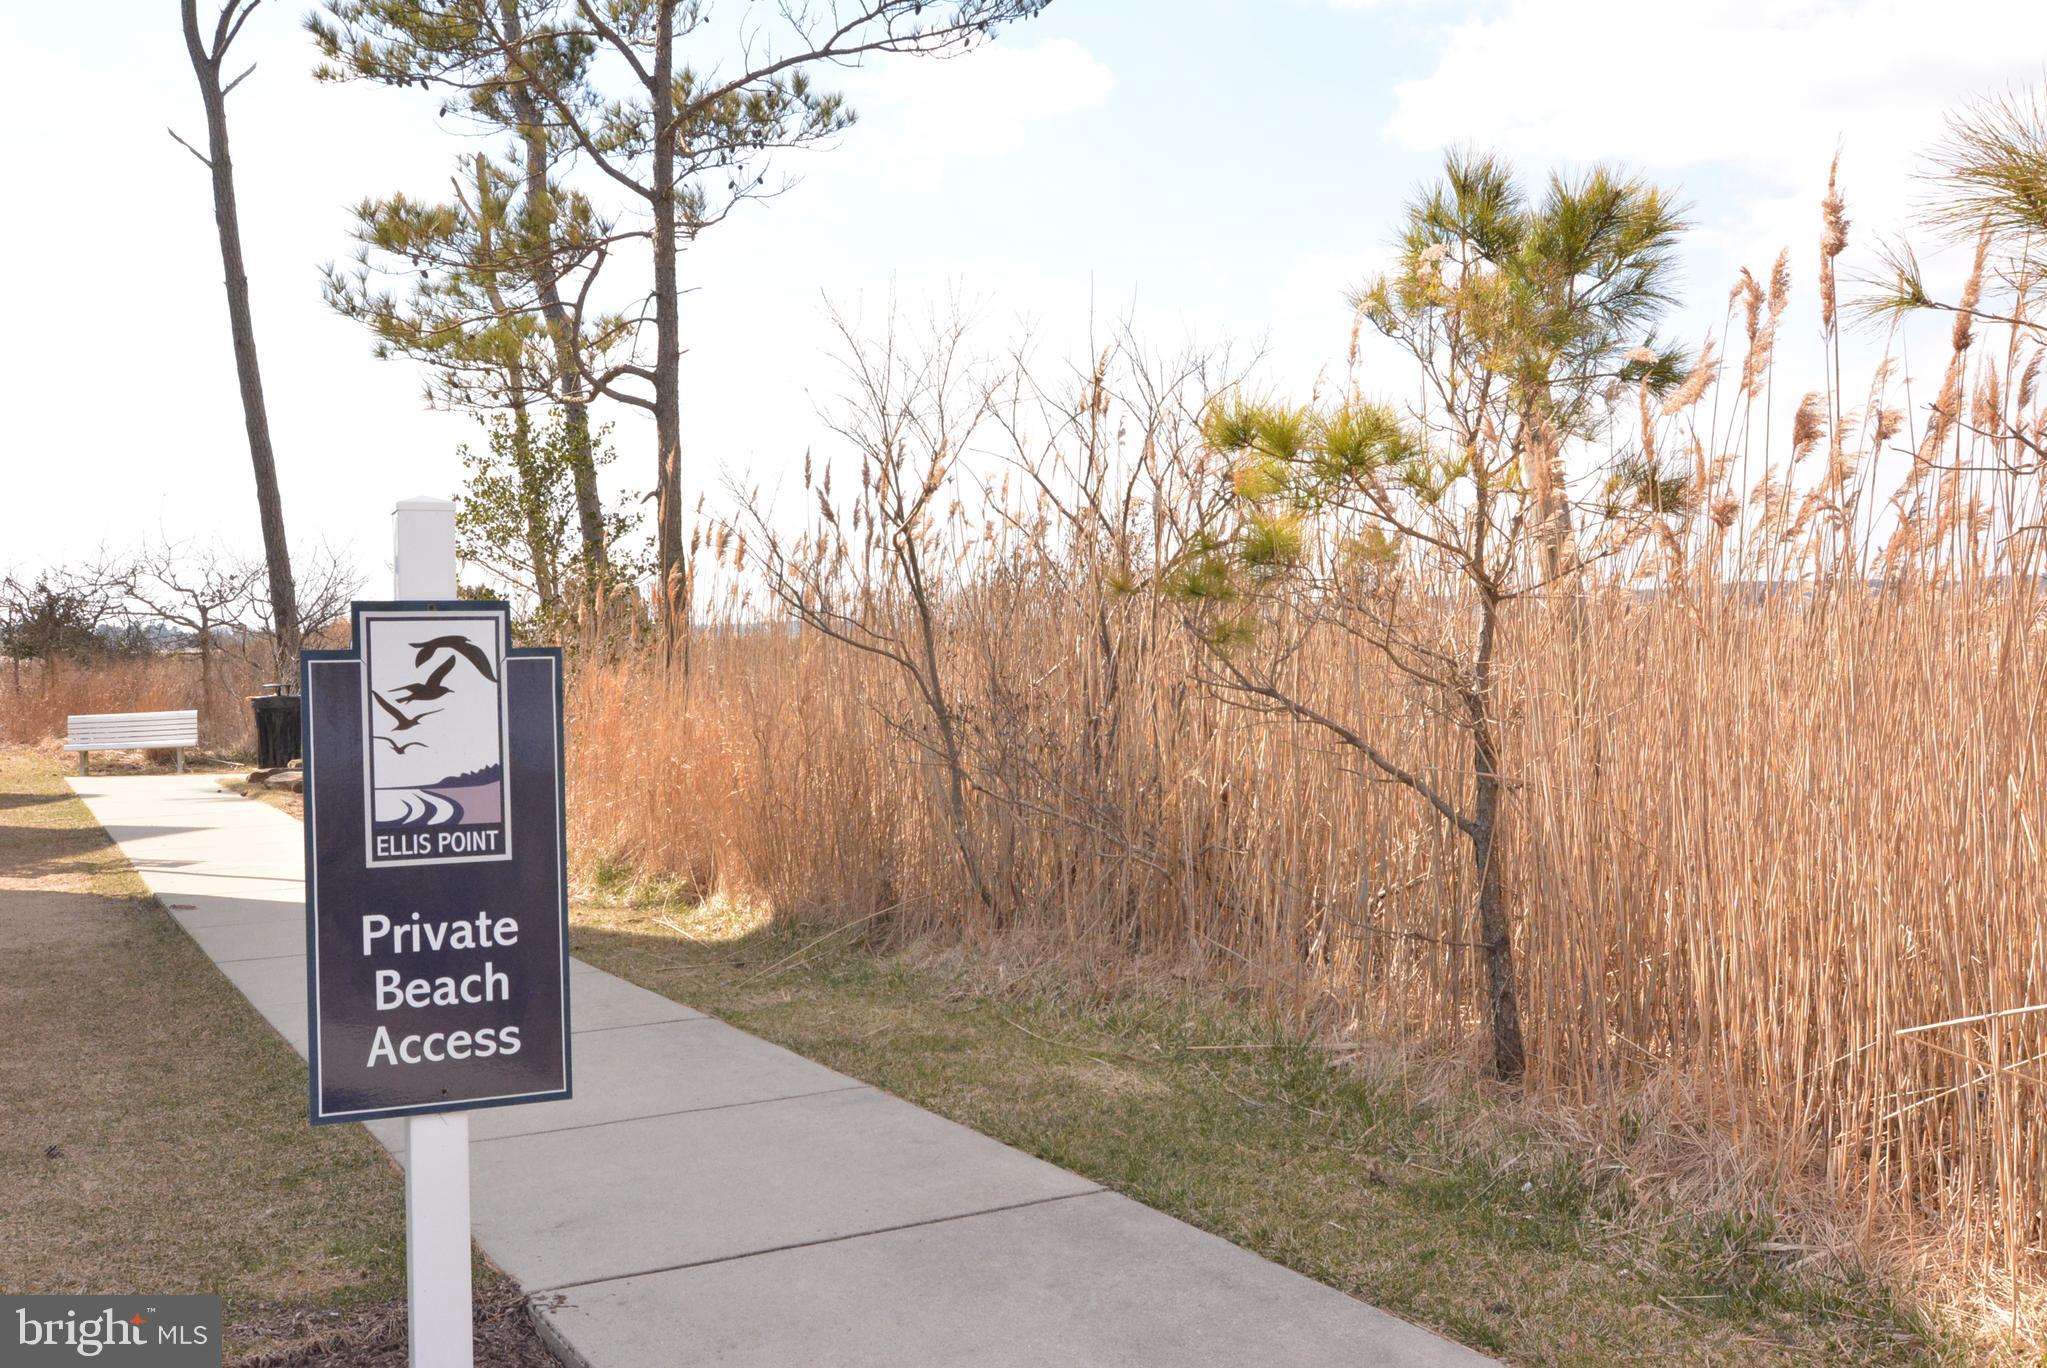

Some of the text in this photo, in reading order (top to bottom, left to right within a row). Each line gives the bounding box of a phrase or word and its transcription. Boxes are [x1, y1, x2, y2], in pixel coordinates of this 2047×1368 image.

[376, 829, 500, 857] ELLIS POINT
[362, 910, 520, 956] Private
[375, 961, 510, 1011] Beach
[366, 1024, 522, 1068] Access
